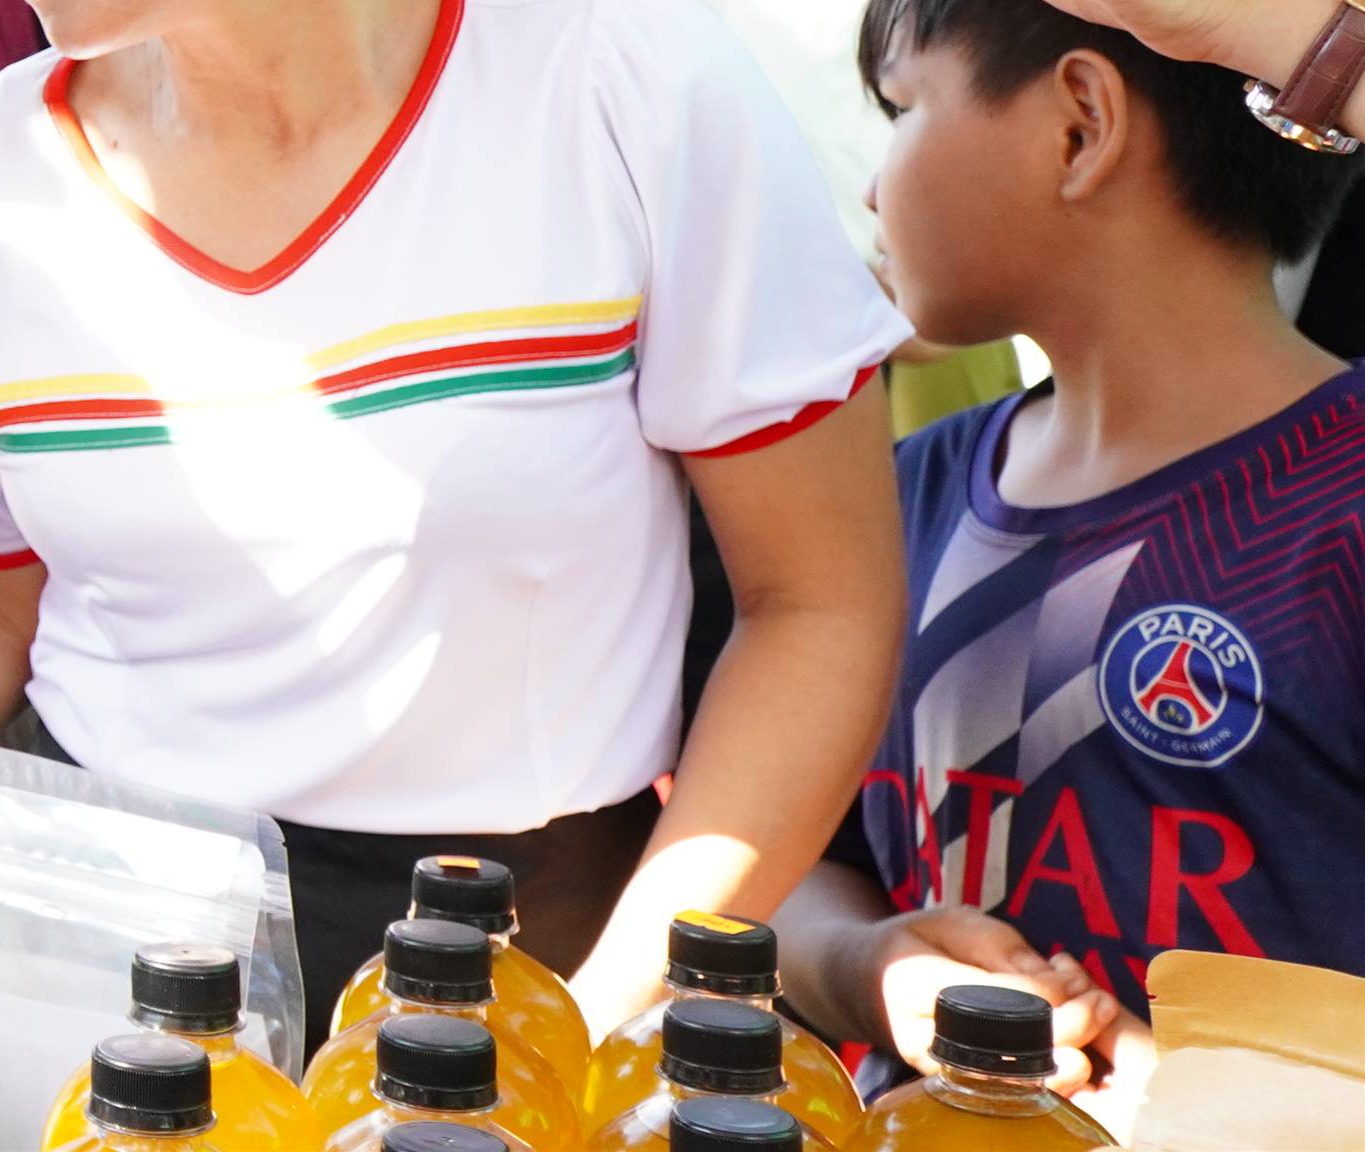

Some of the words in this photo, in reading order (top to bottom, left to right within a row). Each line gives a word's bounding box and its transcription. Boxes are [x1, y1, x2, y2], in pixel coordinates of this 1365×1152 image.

[1138, 613, 1246, 668] PARIS
[1120, 706, 1159, 743] SAINT
[862, 767, 1267, 957] QATAR
